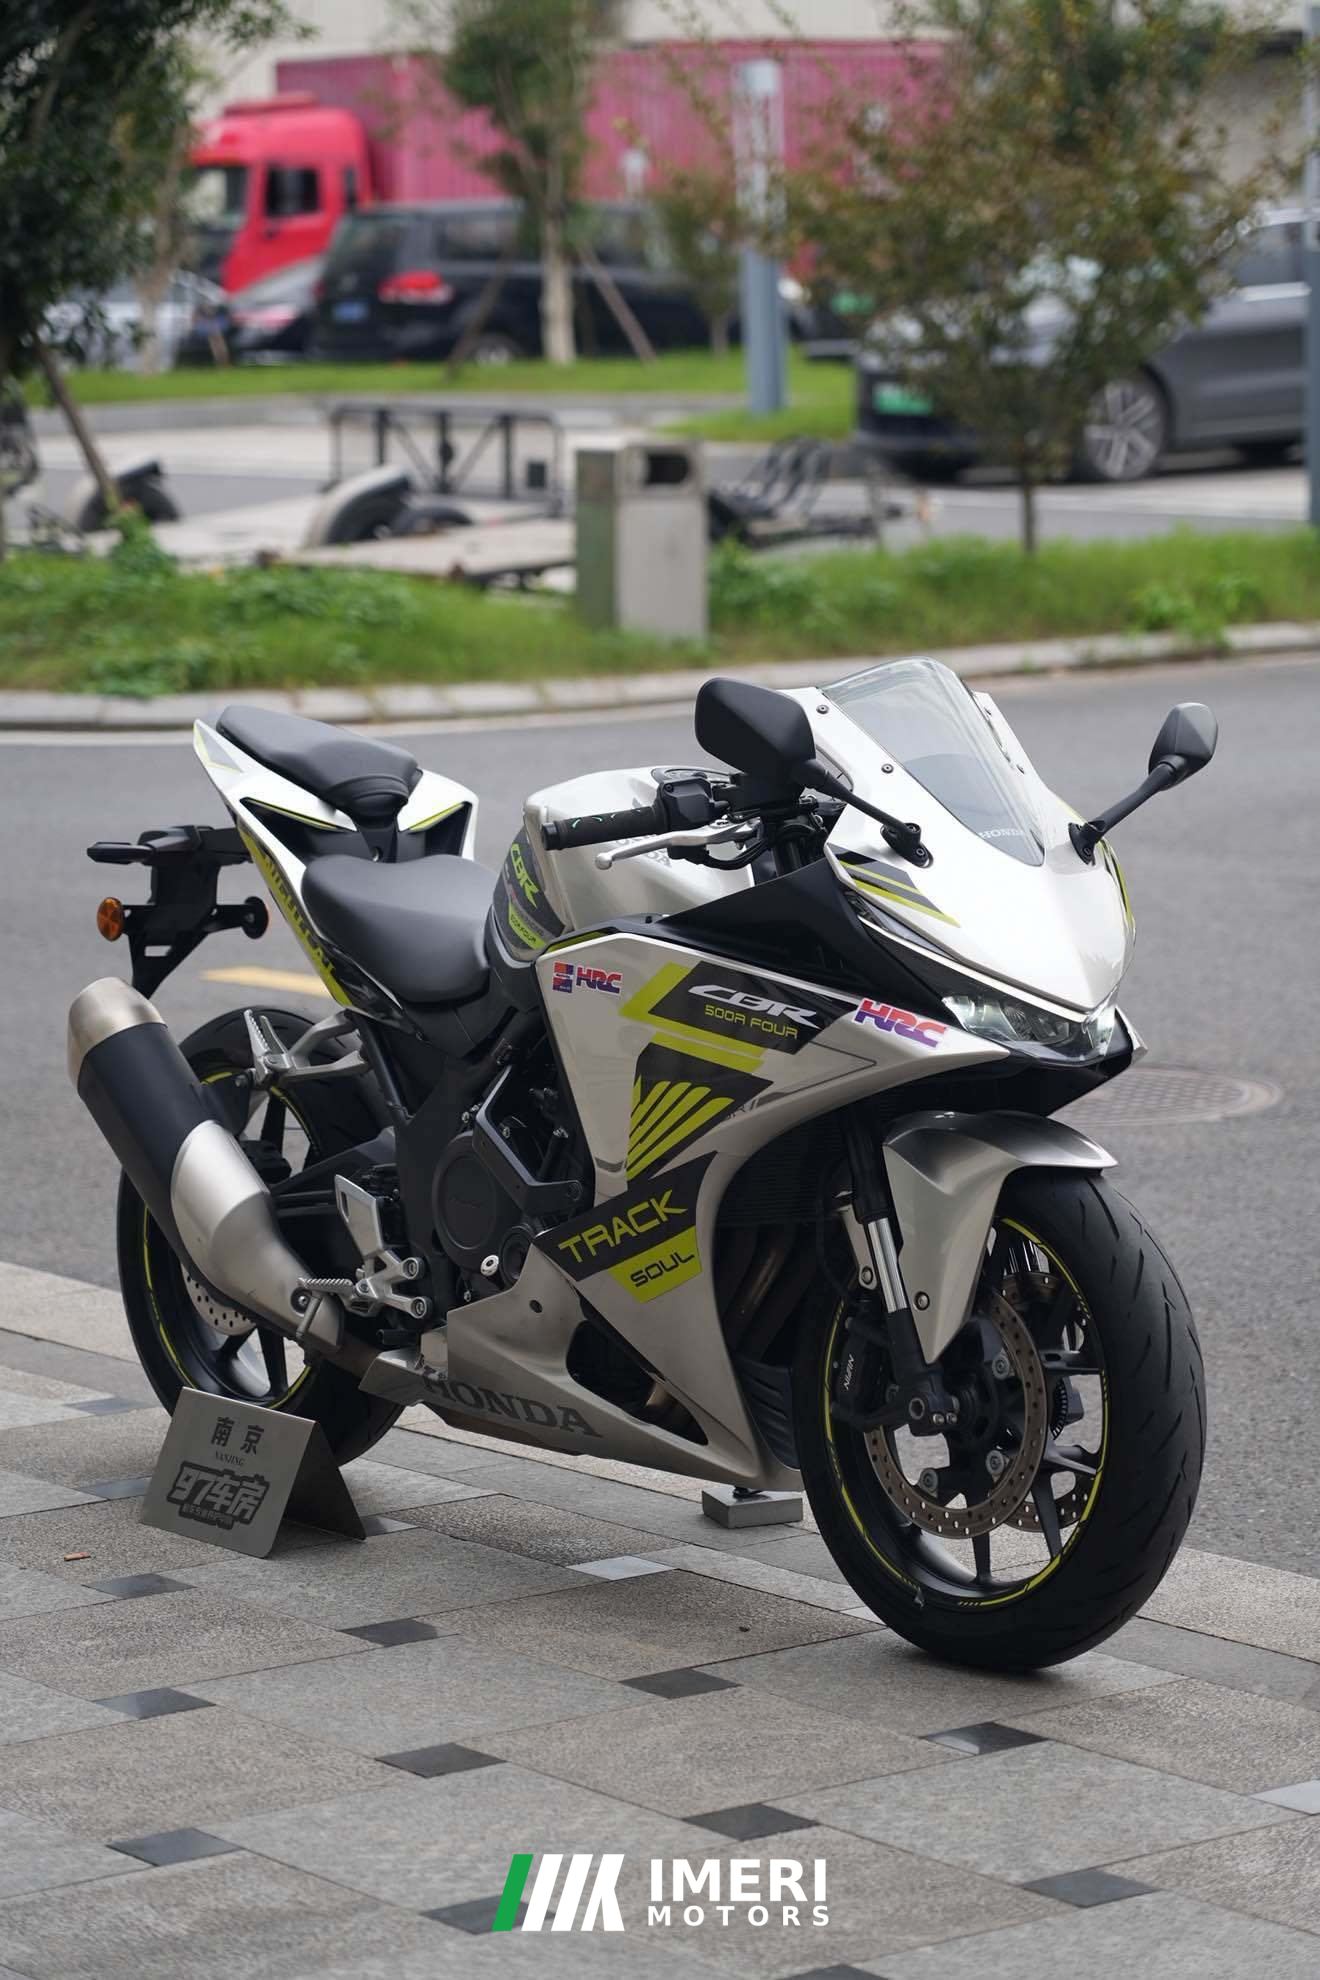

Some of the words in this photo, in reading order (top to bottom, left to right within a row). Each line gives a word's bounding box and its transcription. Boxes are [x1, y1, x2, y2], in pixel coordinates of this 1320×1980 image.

[510, 843, 538, 909] CBR
[575, 965, 622, 994] HRC
[688, 984, 821, 1030] CBR
[704, 1004, 746, 1026] 500R
[750, 1018, 798, 1040] FOUR
[854, 999, 947, 1048] HRC
[558, 1189, 688, 1262] TRACK
[630, 1252, 695, 1287] SOUL
[421, 1374, 604, 1438] HONDA
[210, 1416, 265, 1455] 南京
